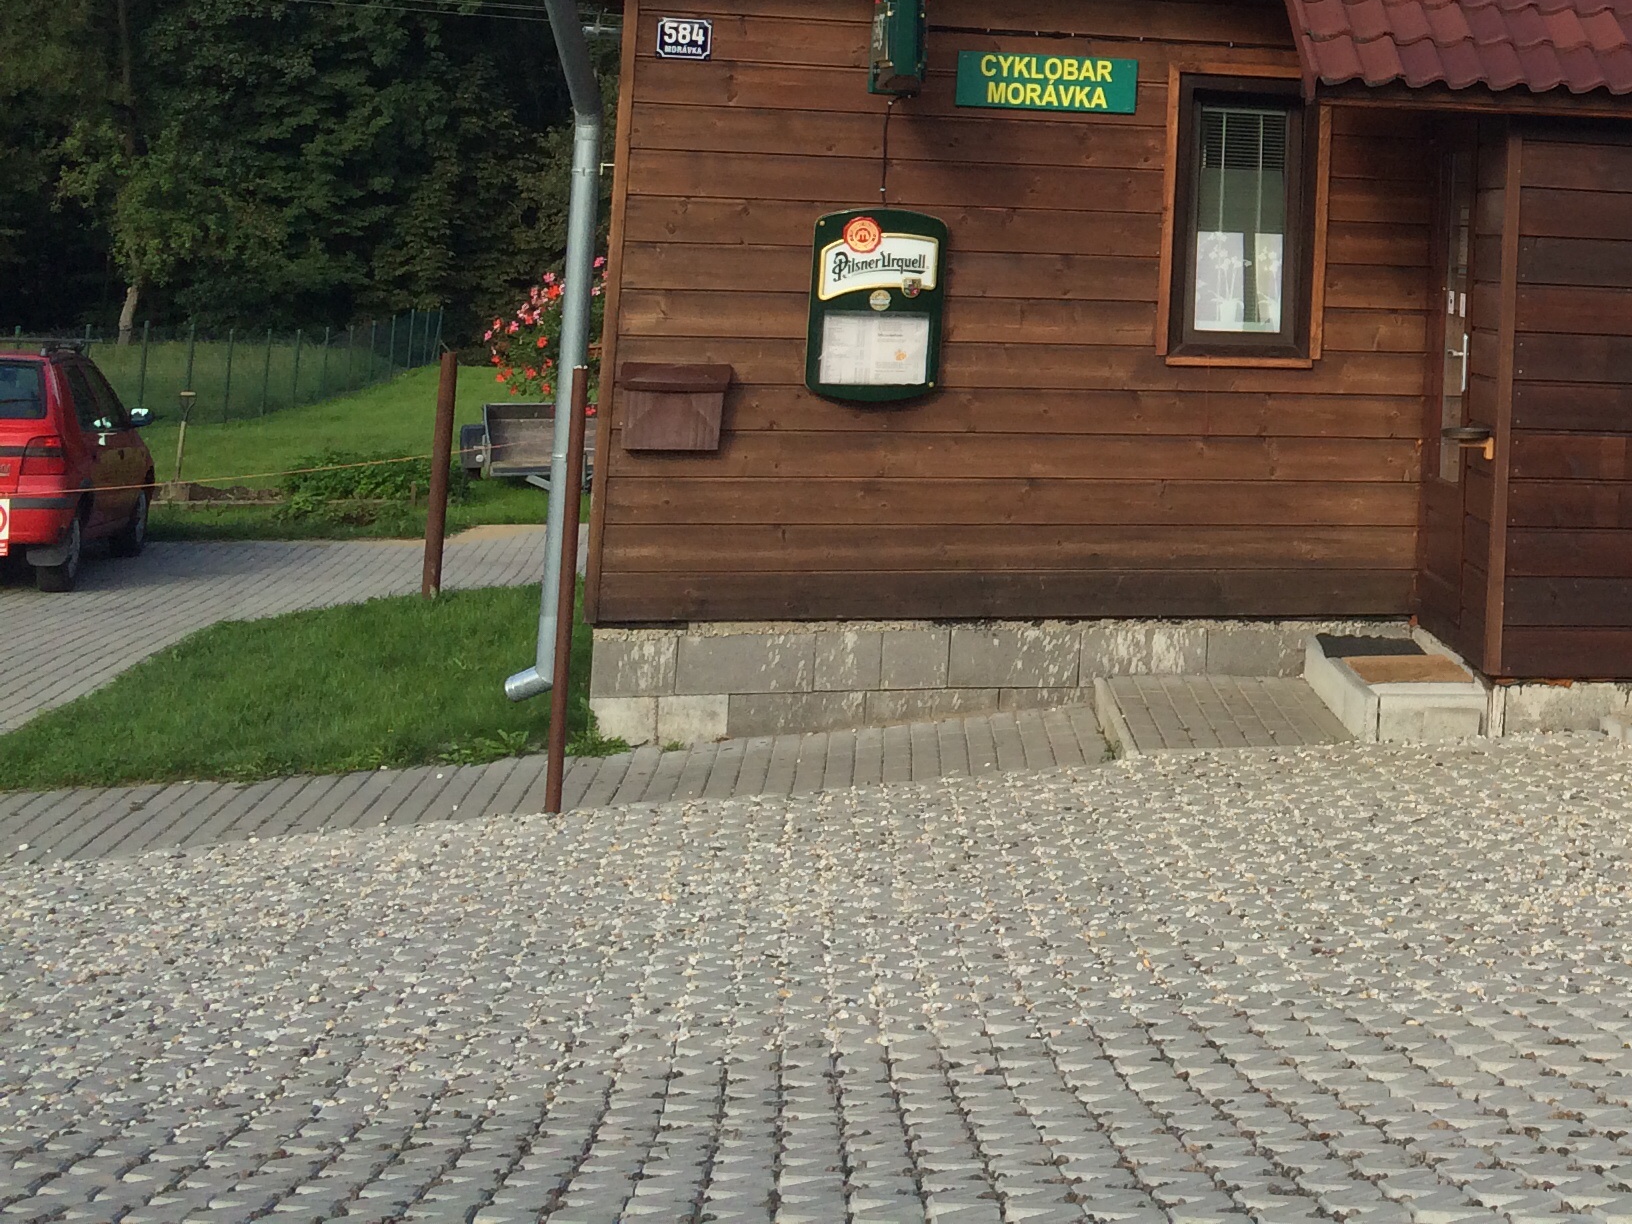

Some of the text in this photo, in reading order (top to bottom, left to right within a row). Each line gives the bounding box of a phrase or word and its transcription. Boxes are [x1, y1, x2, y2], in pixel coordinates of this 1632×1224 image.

[664, 22, 705, 45] 584
[664, 44, 702, 55] MORÁVKA
[981, 54, 1113, 83] CYKLOBAR
[987, 80, 1108, 110] MORÁVKA
[831, 251, 927, 283] Pilsner Urquell
